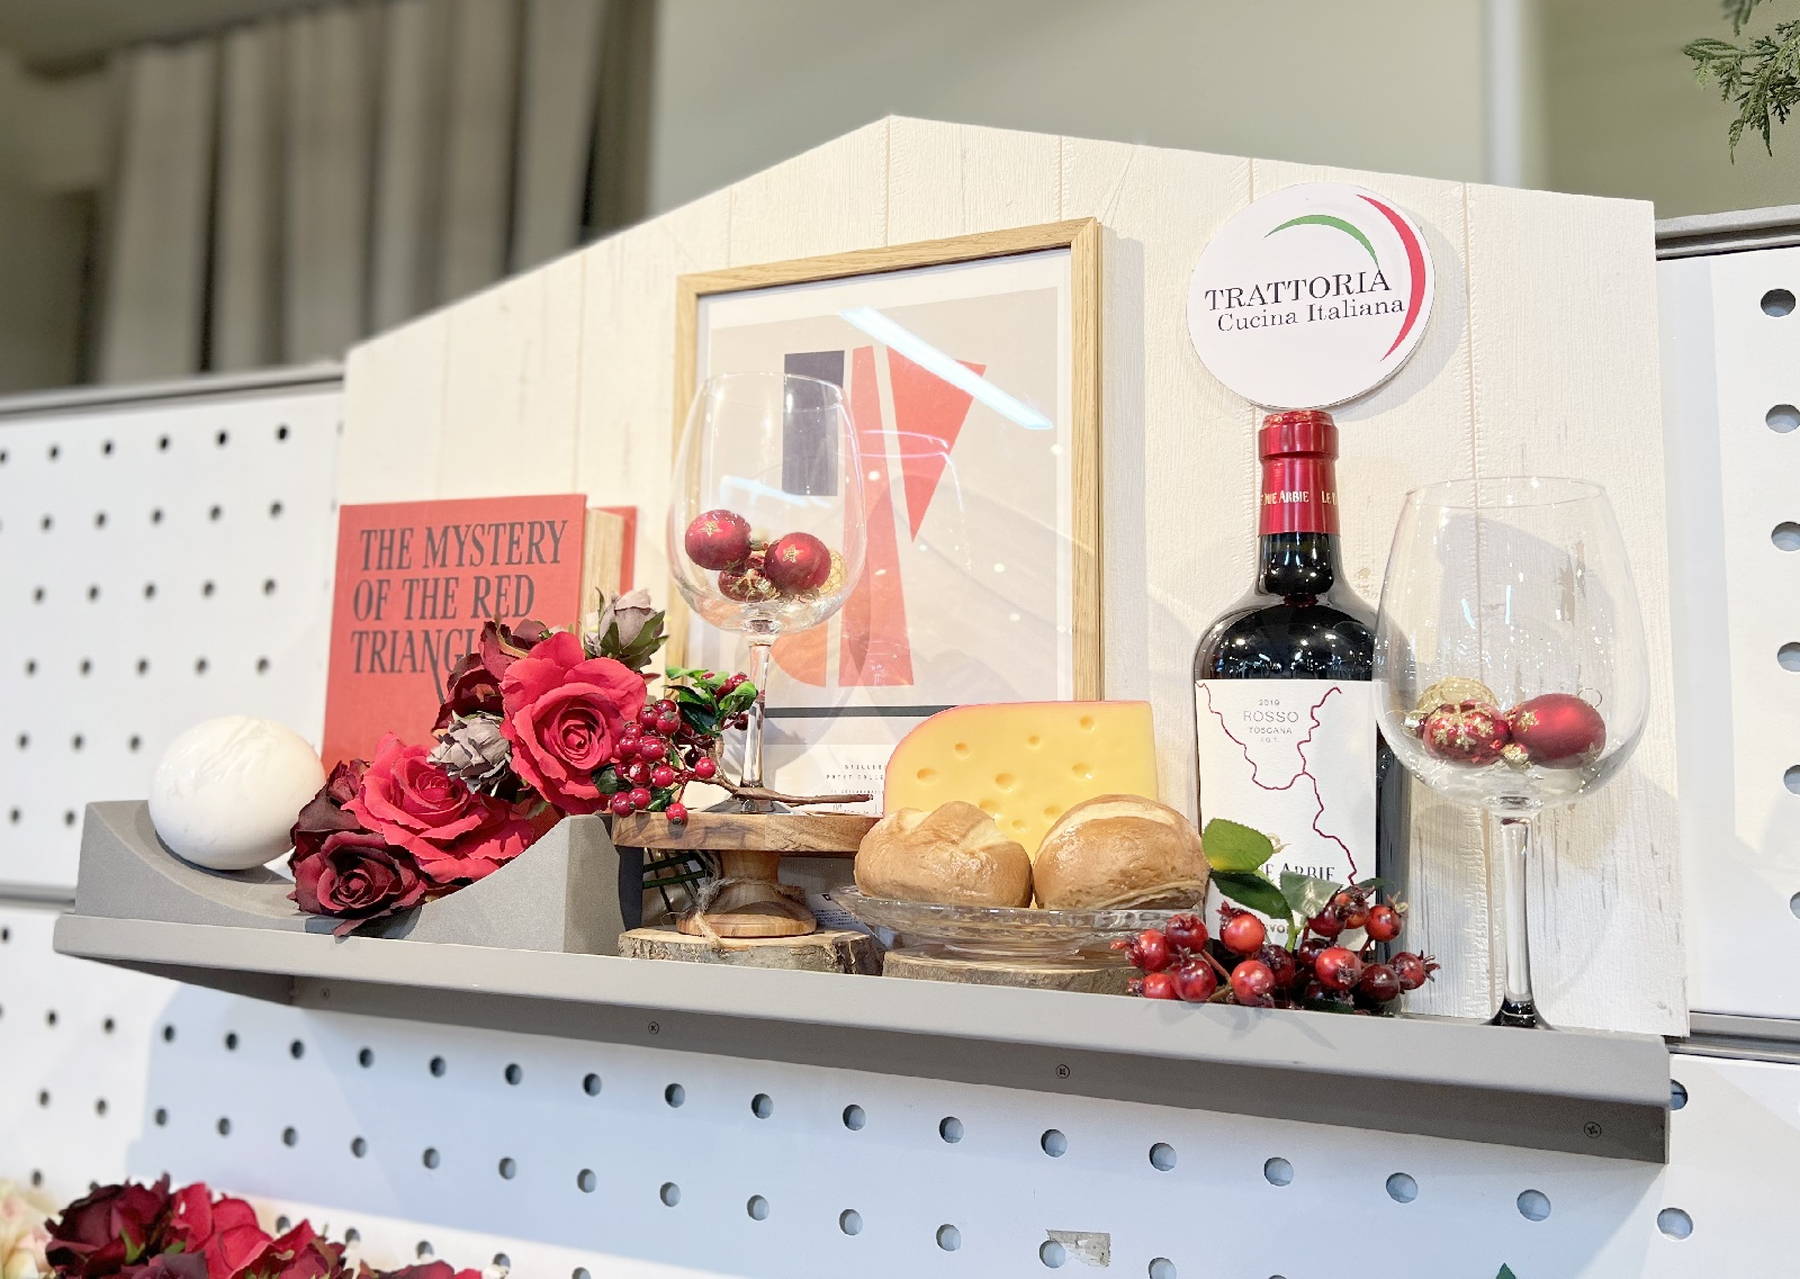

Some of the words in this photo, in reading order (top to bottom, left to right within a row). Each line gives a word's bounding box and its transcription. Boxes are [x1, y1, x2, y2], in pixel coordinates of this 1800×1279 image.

[1204, 268, 1392, 311] TRATTORIA
[1217, 308, 1300, 332] Cucina
[1306, 298, 1406, 323] Italiana
[1279, 490, 1310, 504] ARBIE
[360, 527, 415, 571] THE
[422, 519, 569, 569] MYSTERY
[353, 578, 392, 621] OF
[402, 576, 460, 620] THE
[469, 573, 535, 619] RED
[351, 627, 476, 704] TRIANGL
[1243, 710, 1299, 723] ROSSO
[1249, 727, 1293, 735] TOSCANA
